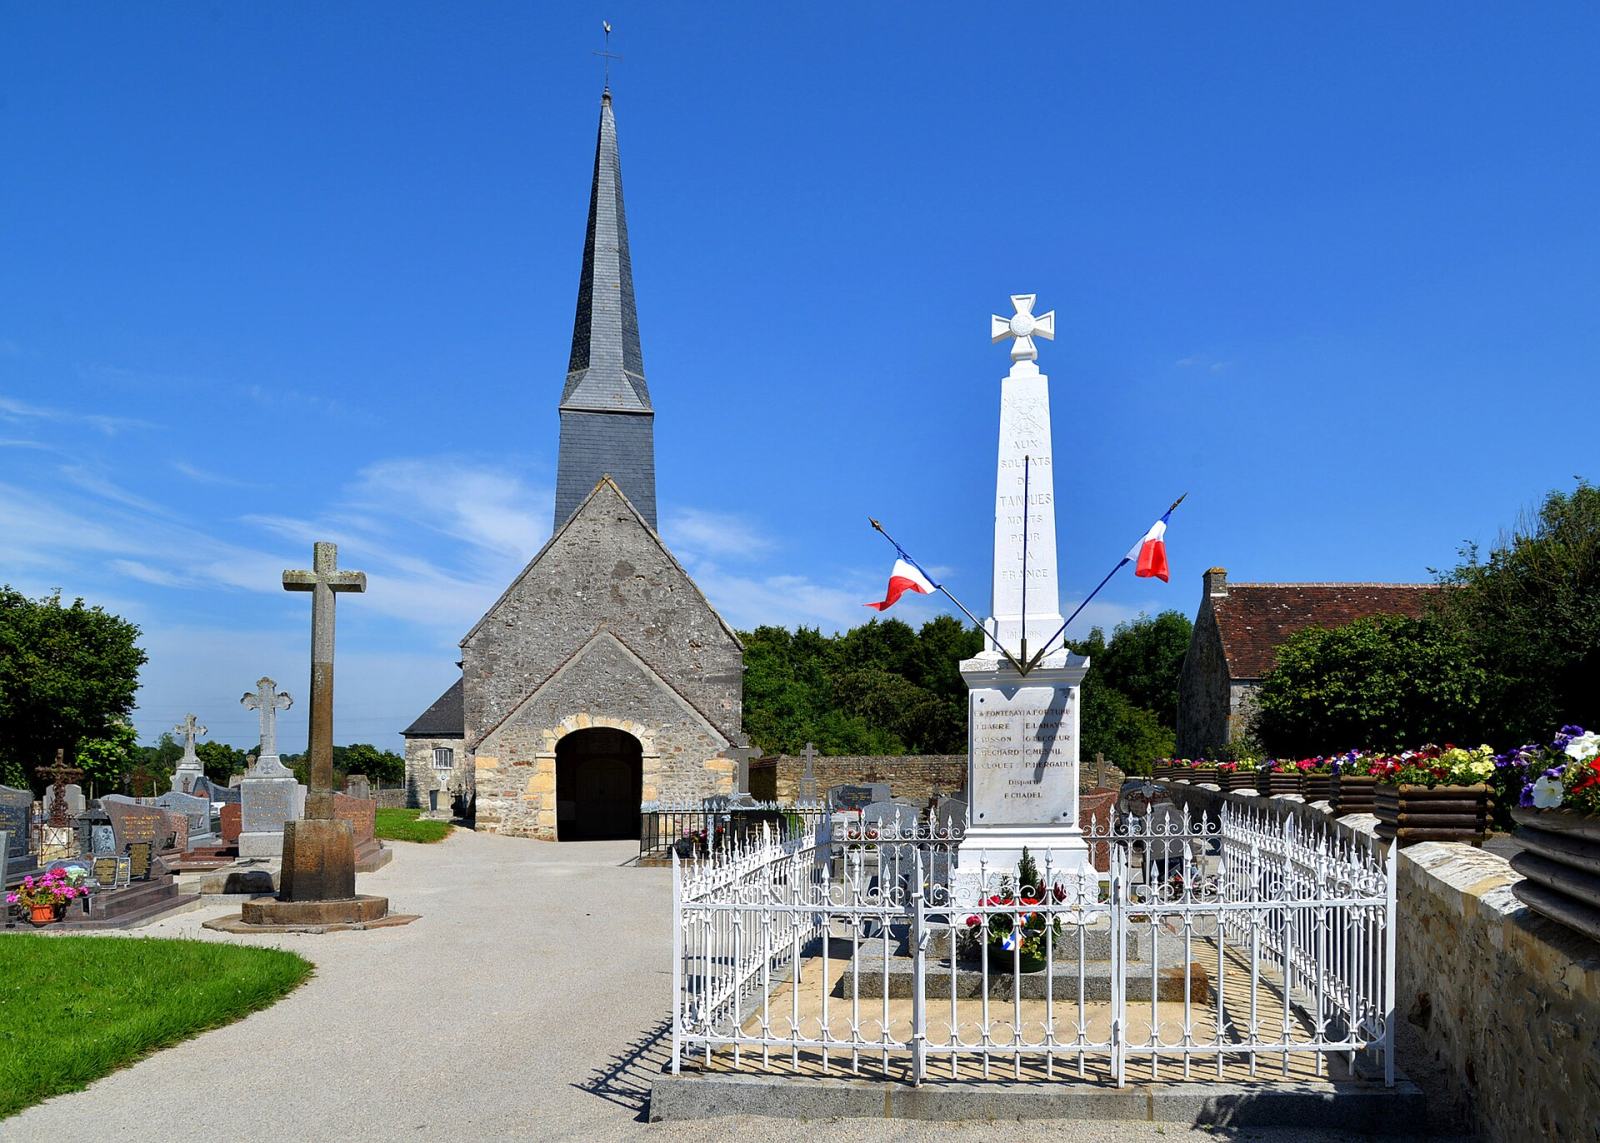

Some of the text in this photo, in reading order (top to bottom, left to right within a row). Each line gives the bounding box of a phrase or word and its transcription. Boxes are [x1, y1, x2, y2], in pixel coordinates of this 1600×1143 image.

[1013, 439, 1039, 450] AUX
[999, 493, 1052, 507] TANUES
[1007, 514, 1043, 526] MOTS
